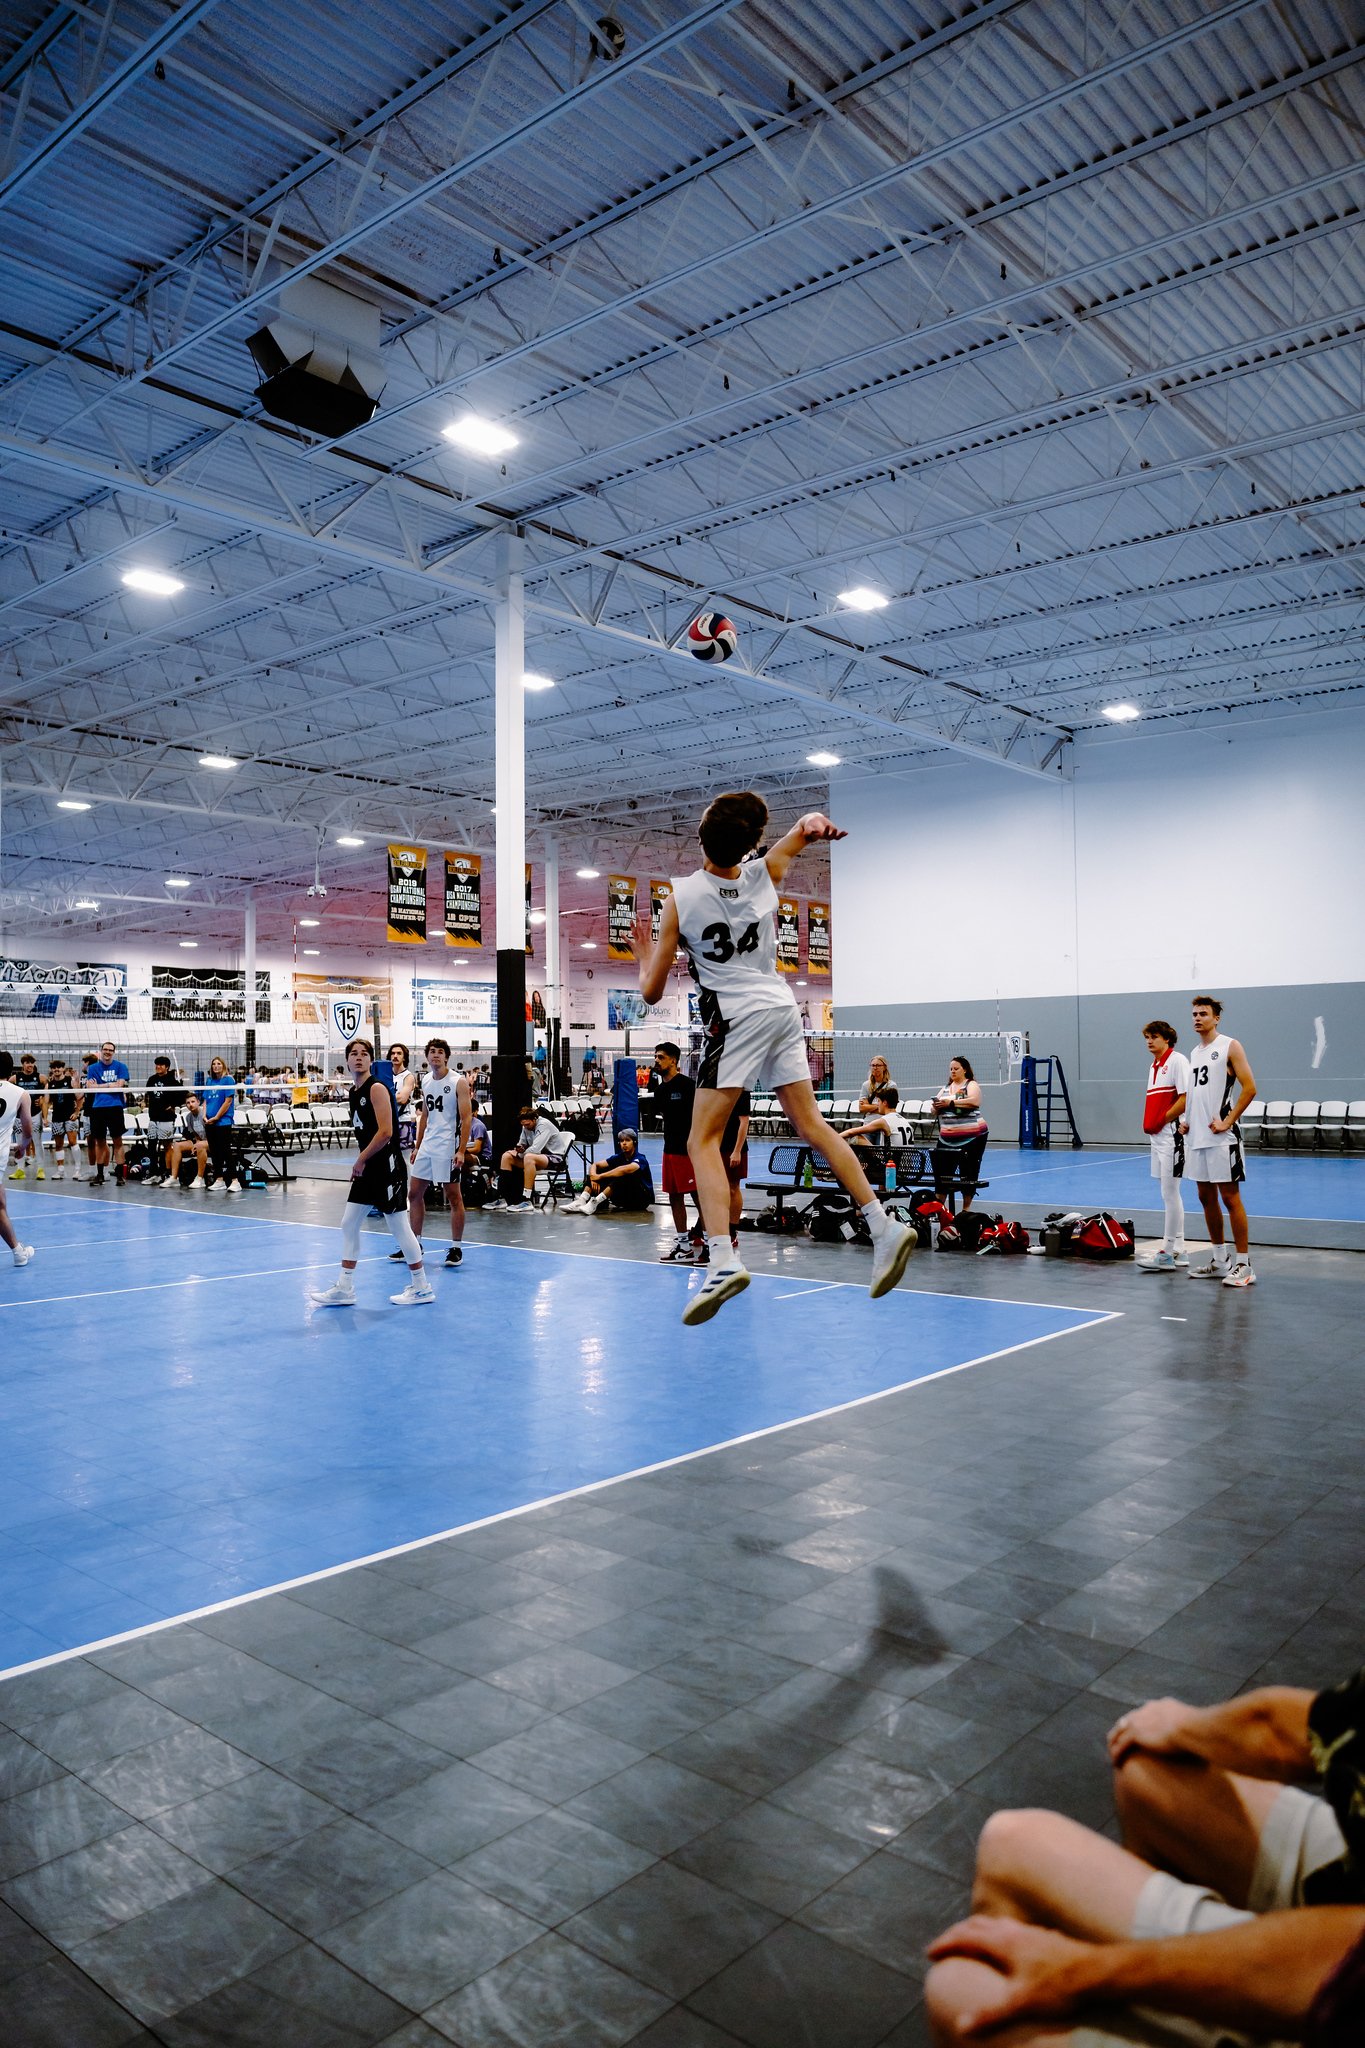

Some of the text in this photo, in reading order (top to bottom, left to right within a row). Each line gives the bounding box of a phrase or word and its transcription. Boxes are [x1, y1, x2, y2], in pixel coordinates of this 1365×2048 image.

[398, 878, 417, 887] 2019
[402, 886, 425, 897] NATIONAL
[454, 884, 472, 893] 2017
[390, 894, 425, 906] CHAMPIONSHIPS
[456, 892, 480, 903] NATIONAL
[446, 900, 480, 911] CHAMPIONSHIPS
[701, 922, 760, 963] 34
[20, 969, 99, 985] ACADEMY
[438, 996, 468, 1004] Franciscan
[170, 1011, 204, 1019] WELCOME
[230, 1012, 245, 1020] FAM
[339, 1007, 356, 1031] 15
[1193, 1065, 1209, 1087] 13
[426, 1094, 444, 1112] 64
[897, 1126, 914, 1145] 12
